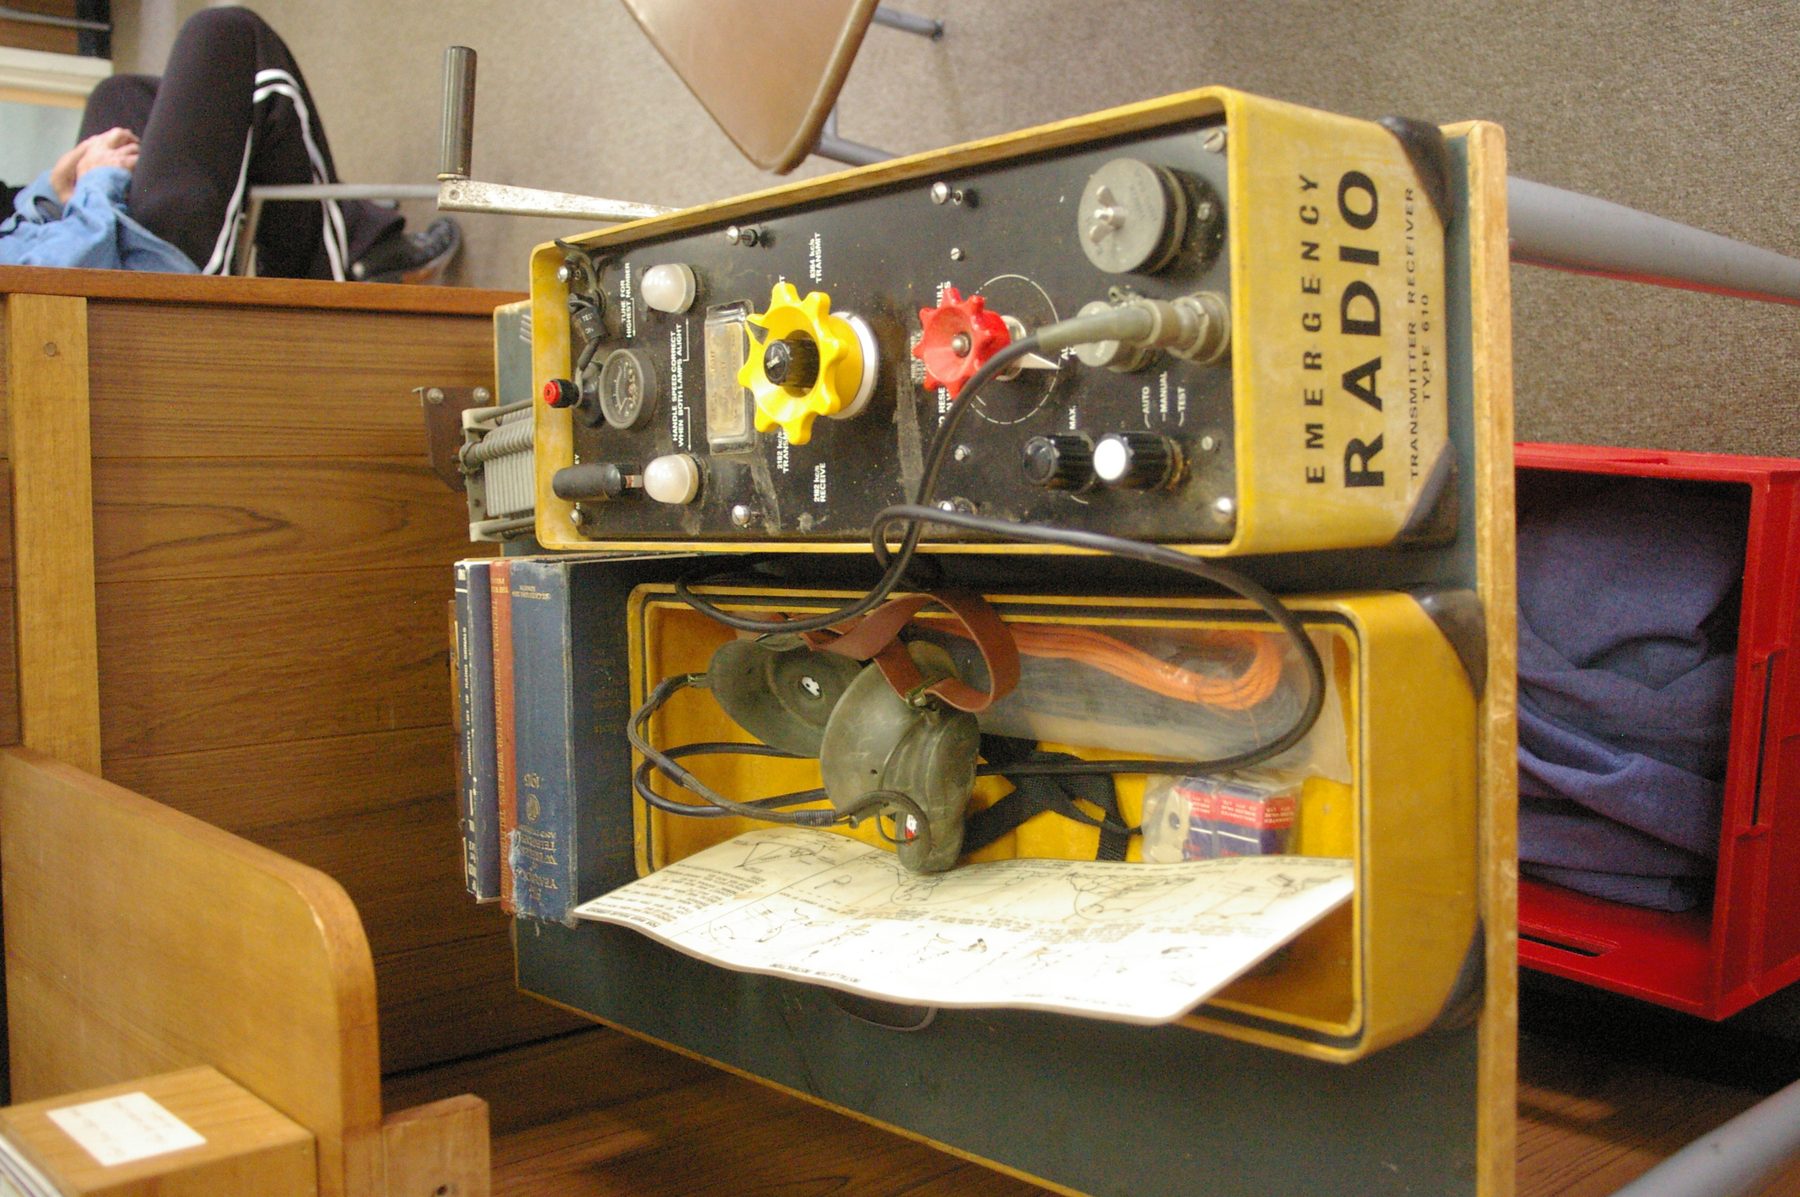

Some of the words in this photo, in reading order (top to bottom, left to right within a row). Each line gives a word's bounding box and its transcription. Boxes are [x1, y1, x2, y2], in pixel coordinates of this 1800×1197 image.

[814, 232, 822, 284] TRANSMIT
[1403, 187, 1416, 305] RECEIVER
[1297, 174, 1326, 485] EMERGENCY
[1337, 170, 1385, 489] RADIO
[1420, 293, 1431, 332] 610
[1142, 386, 1150, 414] AUTO
[1159, 371, 1168, 413] MANUAL
[1177, 387, 1185, 412] TEST
[1407, 322, 1419, 479] TRANSMITTER
[1421, 345, 1431, 402] TYPE
